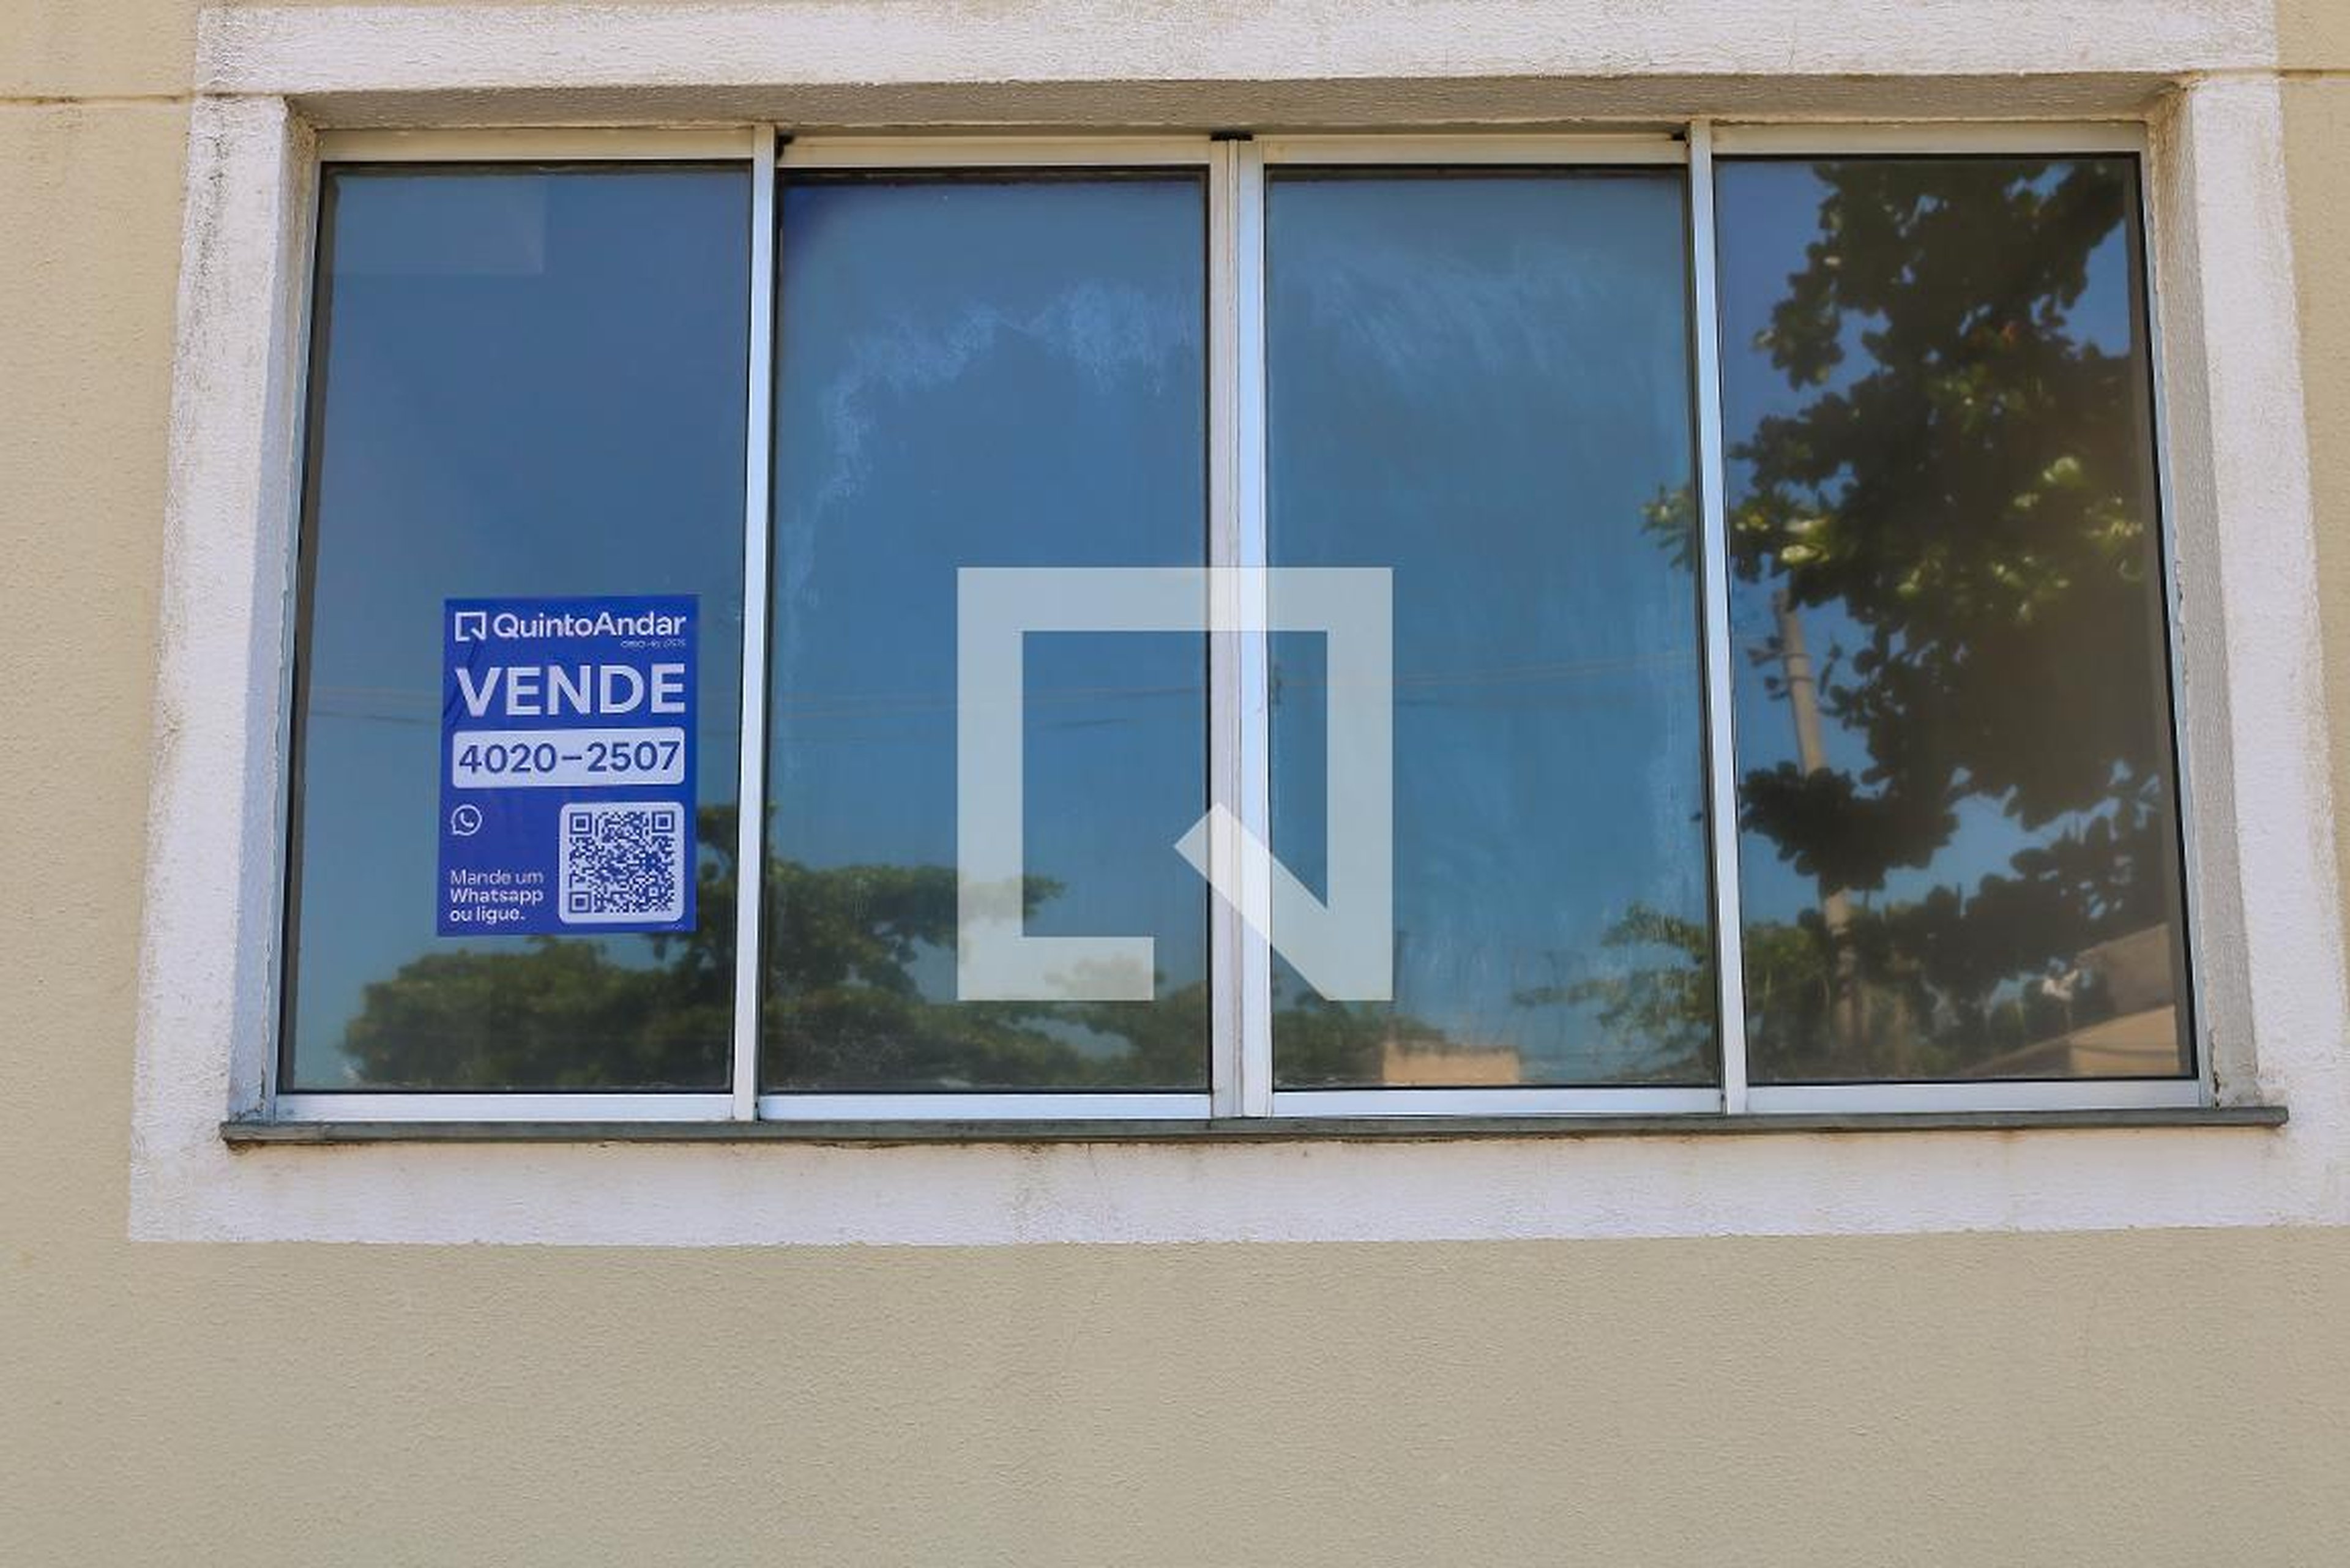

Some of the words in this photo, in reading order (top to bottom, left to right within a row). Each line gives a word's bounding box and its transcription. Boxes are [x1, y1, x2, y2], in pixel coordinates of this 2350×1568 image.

[493, 612, 687, 638] QuintoAndar
[455, 664, 685, 716] VENDE
[459, 741, 681, 774] 4020-2507
[450, 869, 512, 885] Mande
[515, 872, 544, 884] um
[450, 888, 543, 905] Whatsapp
[450, 909, 472, 922] ou
[477, 906, 526, 925] ligue.
